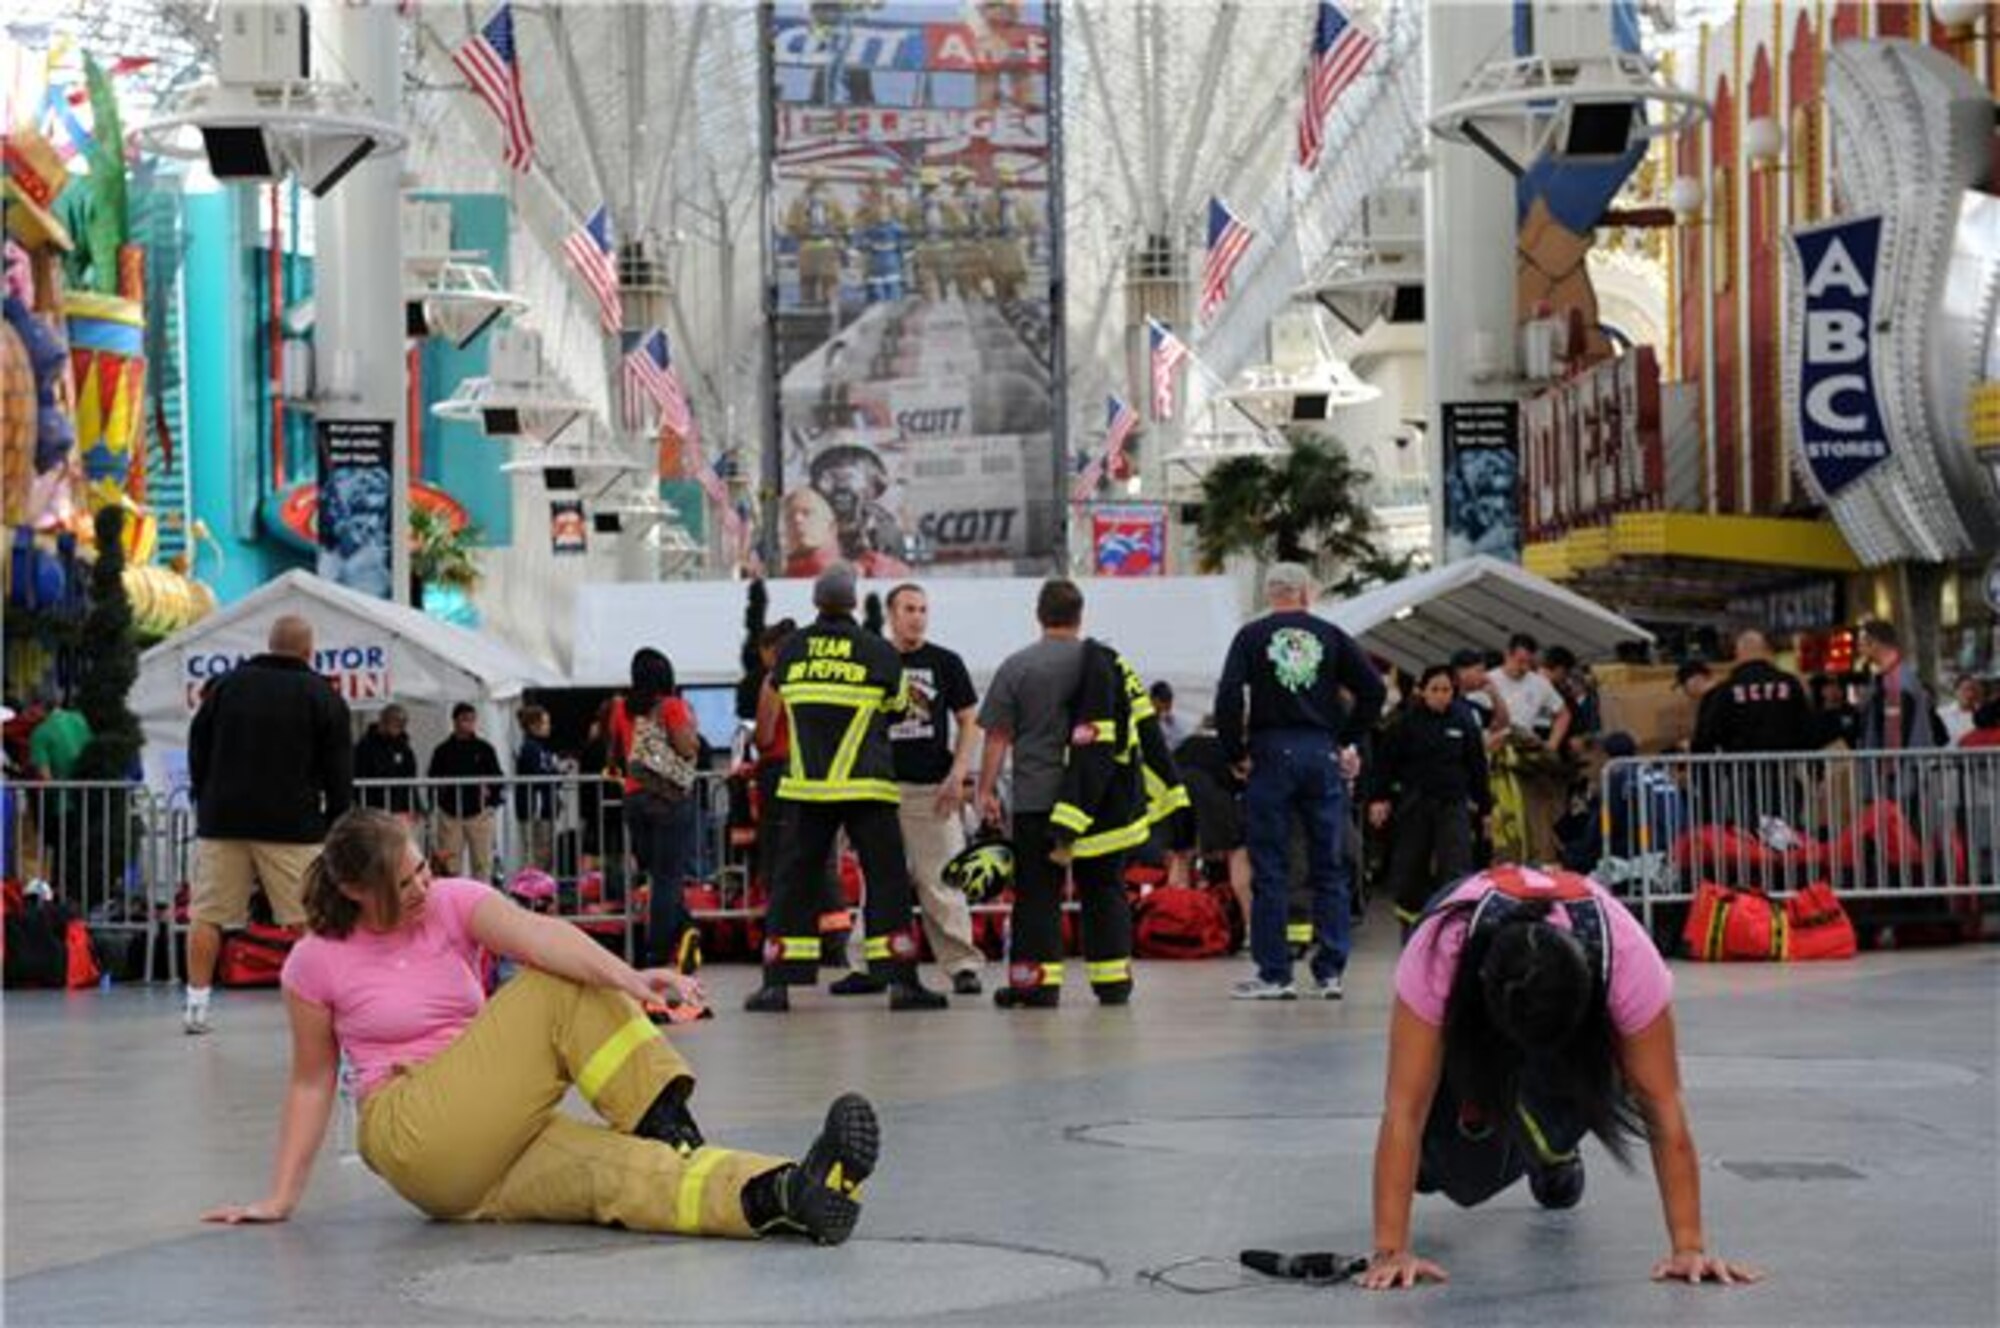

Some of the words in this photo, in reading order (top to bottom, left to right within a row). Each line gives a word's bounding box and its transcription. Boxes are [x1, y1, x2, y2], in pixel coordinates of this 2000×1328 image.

[1808, 440, 1886, 458] STORES
[919, 508, 1018, 545] SCOTT
[807, 635, 852, 659] TEAM
[187, 647, 384, 679] COITOR
[807, 658, 868, 682] PEPPER
